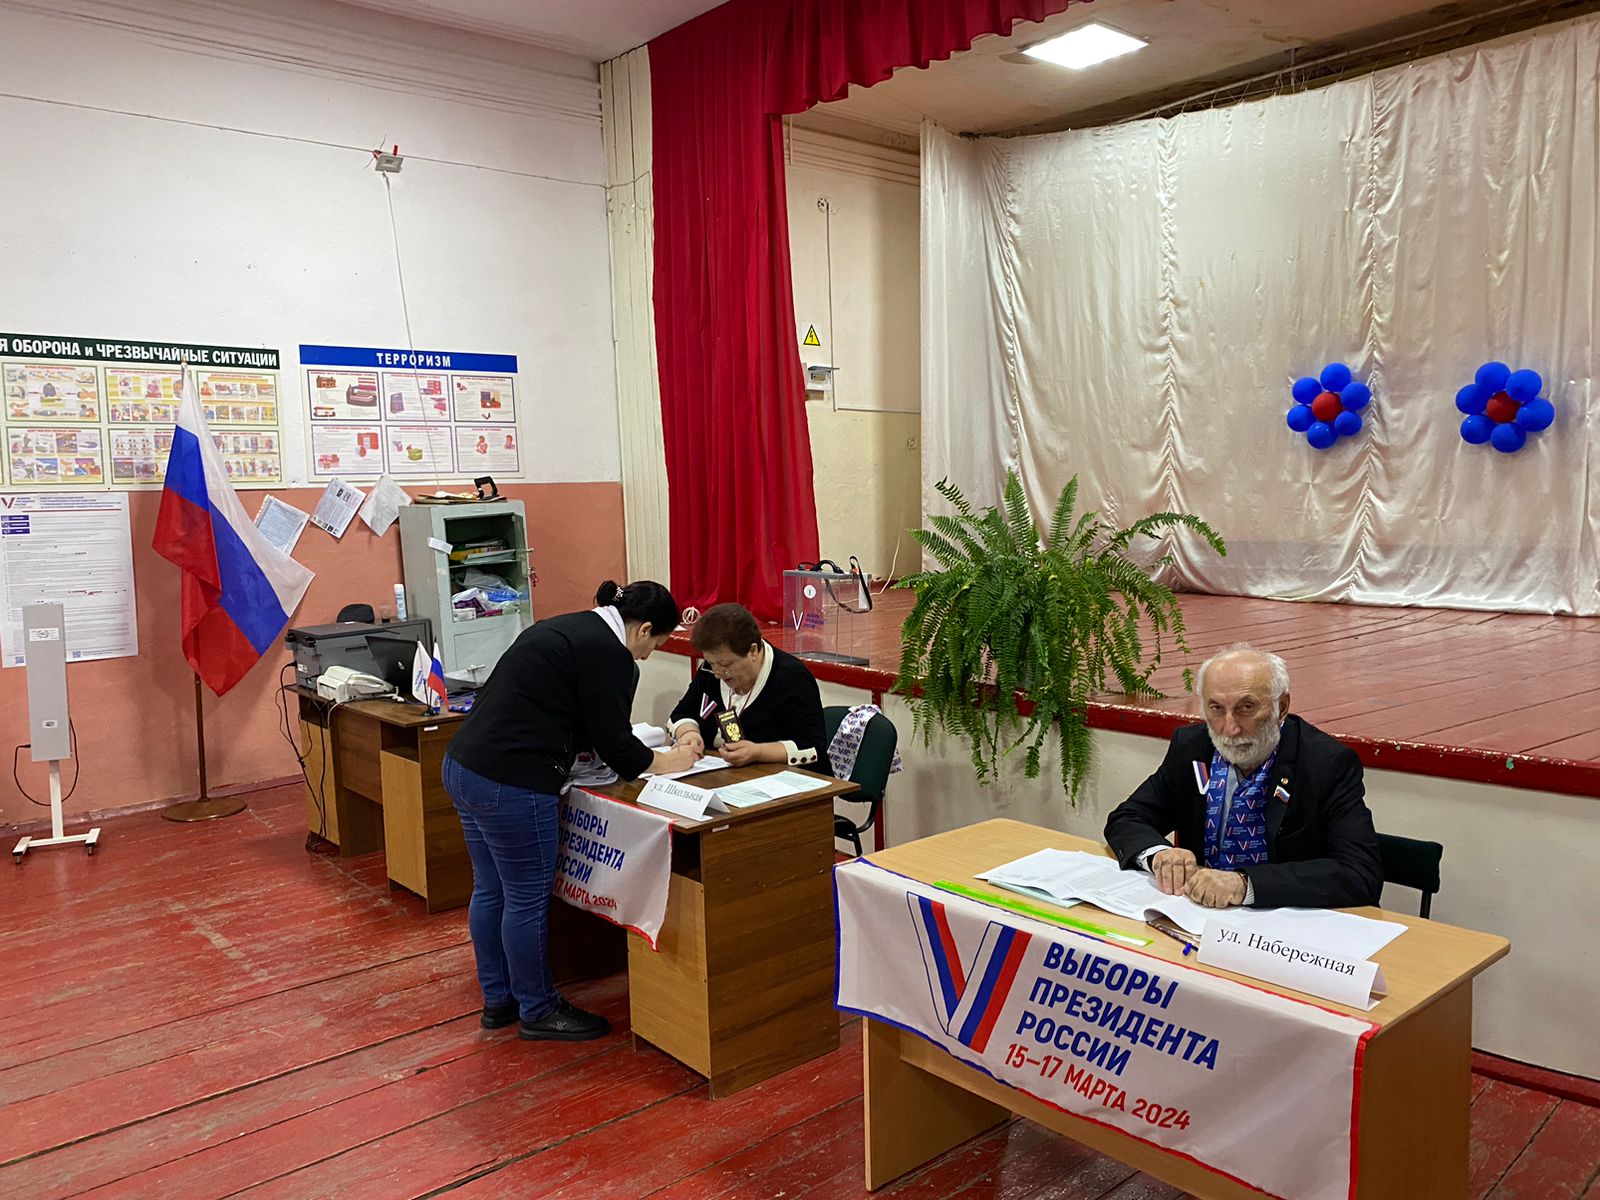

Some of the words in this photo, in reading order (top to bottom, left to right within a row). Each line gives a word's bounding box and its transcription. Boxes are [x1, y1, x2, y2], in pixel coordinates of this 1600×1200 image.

[12, 339, 81, 356] ОБОРОНА
[96, 344, 209, 363] ЧРЕЗВЫЧАЙНЫЕ
[212, 350, 277, 367] СИТУАЦИИ
[376, 352, 451, 368] ТЕРРОРИЗМ
[664, 784, 704, 802] Школьная
[562, 804, 609, 838] ВЫБОРЫ
[555, 853, 593, 884] ОССИИ
[563, 881, 591, 905] МАРТА
[592, 895, 617, 910] 2024
[1217, 929, 1242, 945] ул.
[1247, 933, 1356, 978] Набережная
[1042, 941, 1179, 1010] ВЫБОРЫ
[1028, 977, 1222, 1071] ПРЕЗИДЕНТА
[1015, 1010, 1132, 1077] РОССИИ
[1063, 1064, 1127, 1113] МАРТА
[1131, 1097, 1191, 1131] 2024
